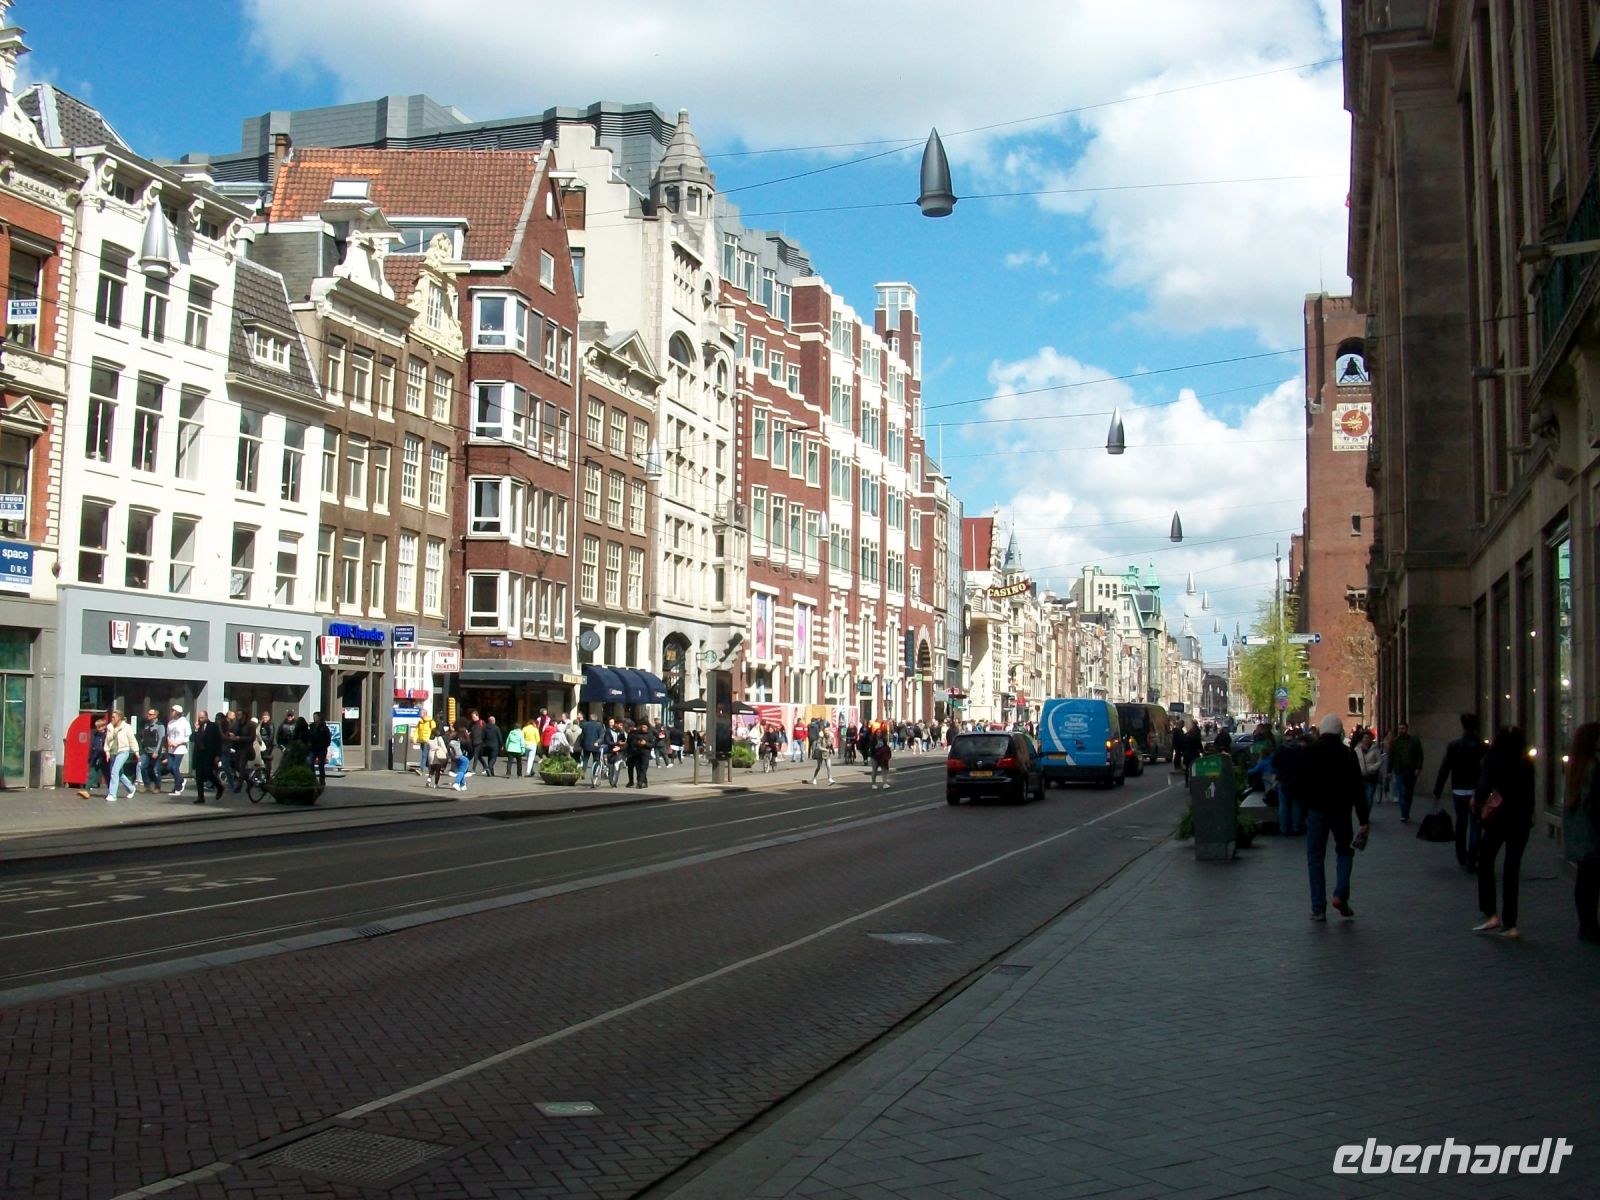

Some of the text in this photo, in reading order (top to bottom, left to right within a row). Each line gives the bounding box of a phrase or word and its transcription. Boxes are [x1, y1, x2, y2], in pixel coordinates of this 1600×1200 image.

[2, 548, 29, 560] space
[10, 564, 27, 575] DRS
[986, 582, 1026, 597] CASINO
[133, 622, 190, 653] KFC
[256, 633, 305, 661] KFC
